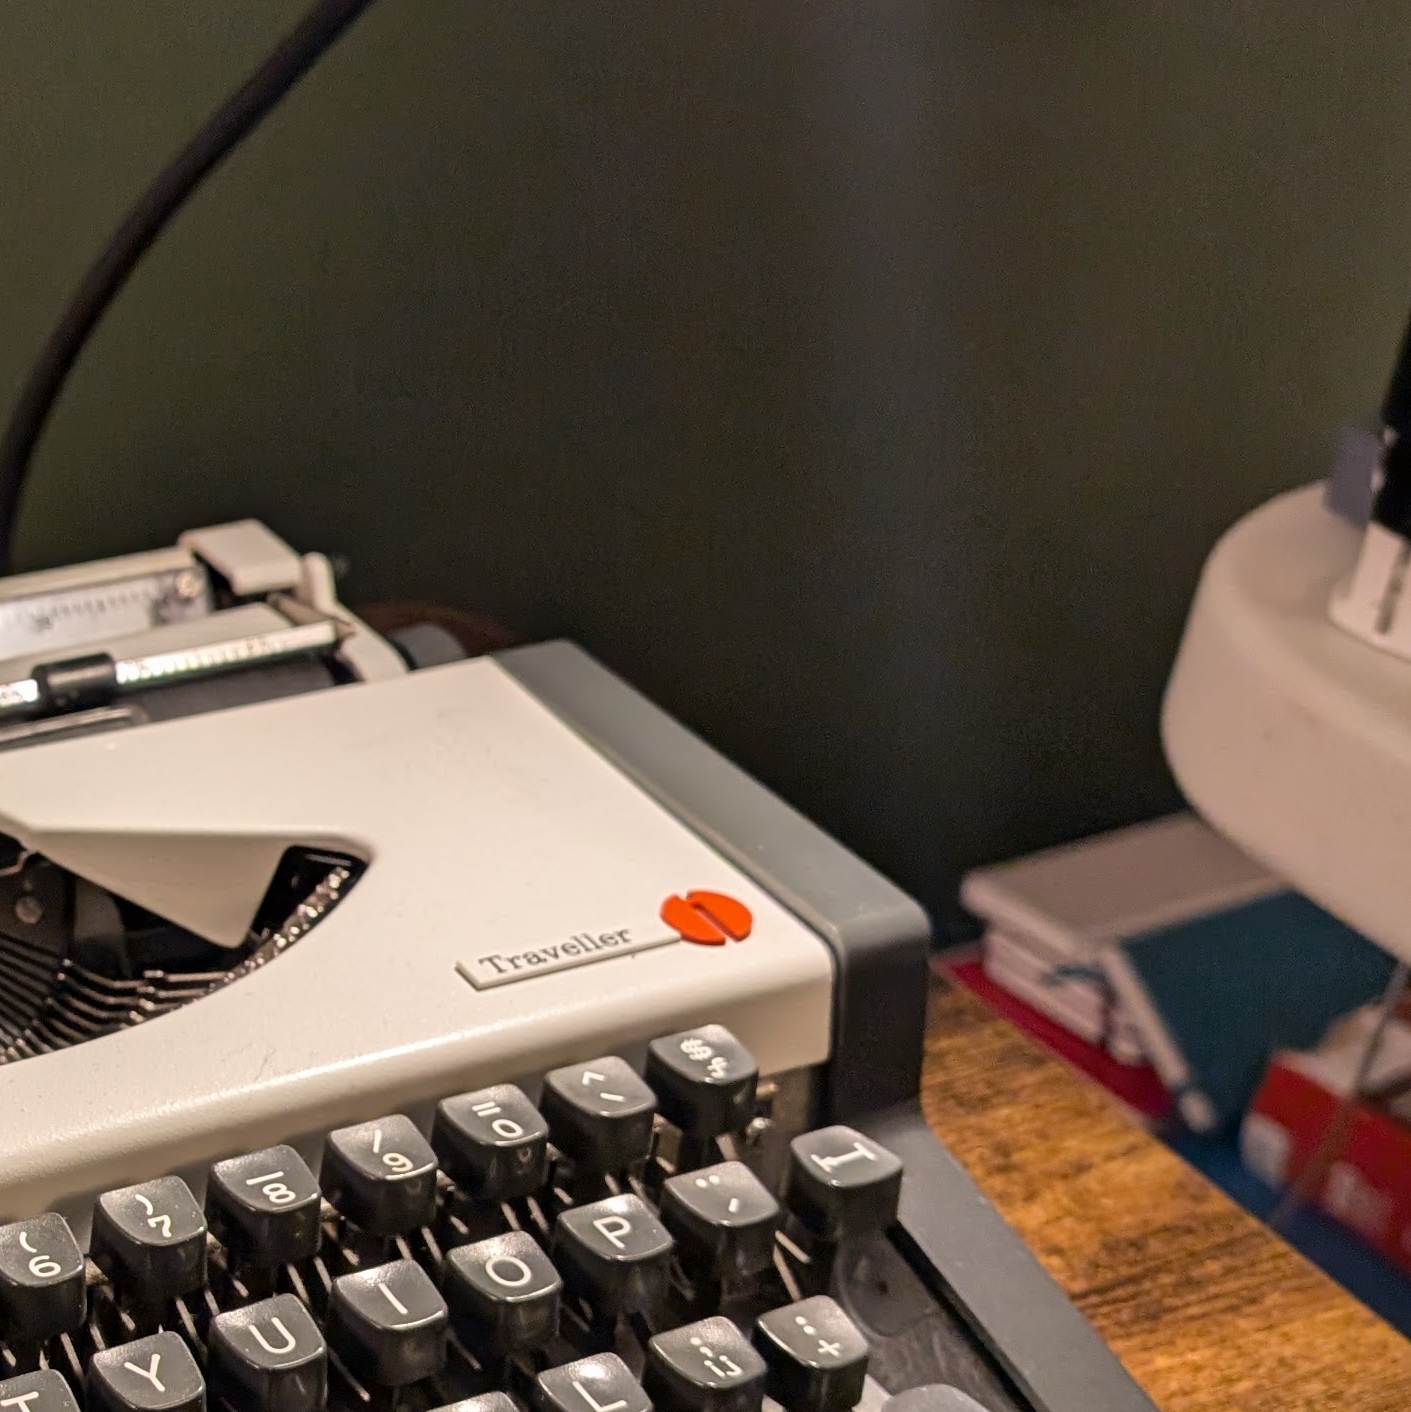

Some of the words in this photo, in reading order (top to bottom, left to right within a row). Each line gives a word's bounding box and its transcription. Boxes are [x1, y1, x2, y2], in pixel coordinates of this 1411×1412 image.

[478, 928, 633, 975] Traveller
[680, 1038, 713, 1061] $
[382, 1152, 413, 1173] 9
[262, 1182, 297, 1204] 8
[147, 1214, 171, 1237] 7
[593, 1215, 631, 1249] P
[29, 1254, 61, 1278] 6
[485, 1256, 531, 1287] O
[378, 1279, 408, 1314] I
[248, 1316, 297, 1354] U
[124, 1353, 165, 1392] Y
[572, 1380, 628, 1412] L
